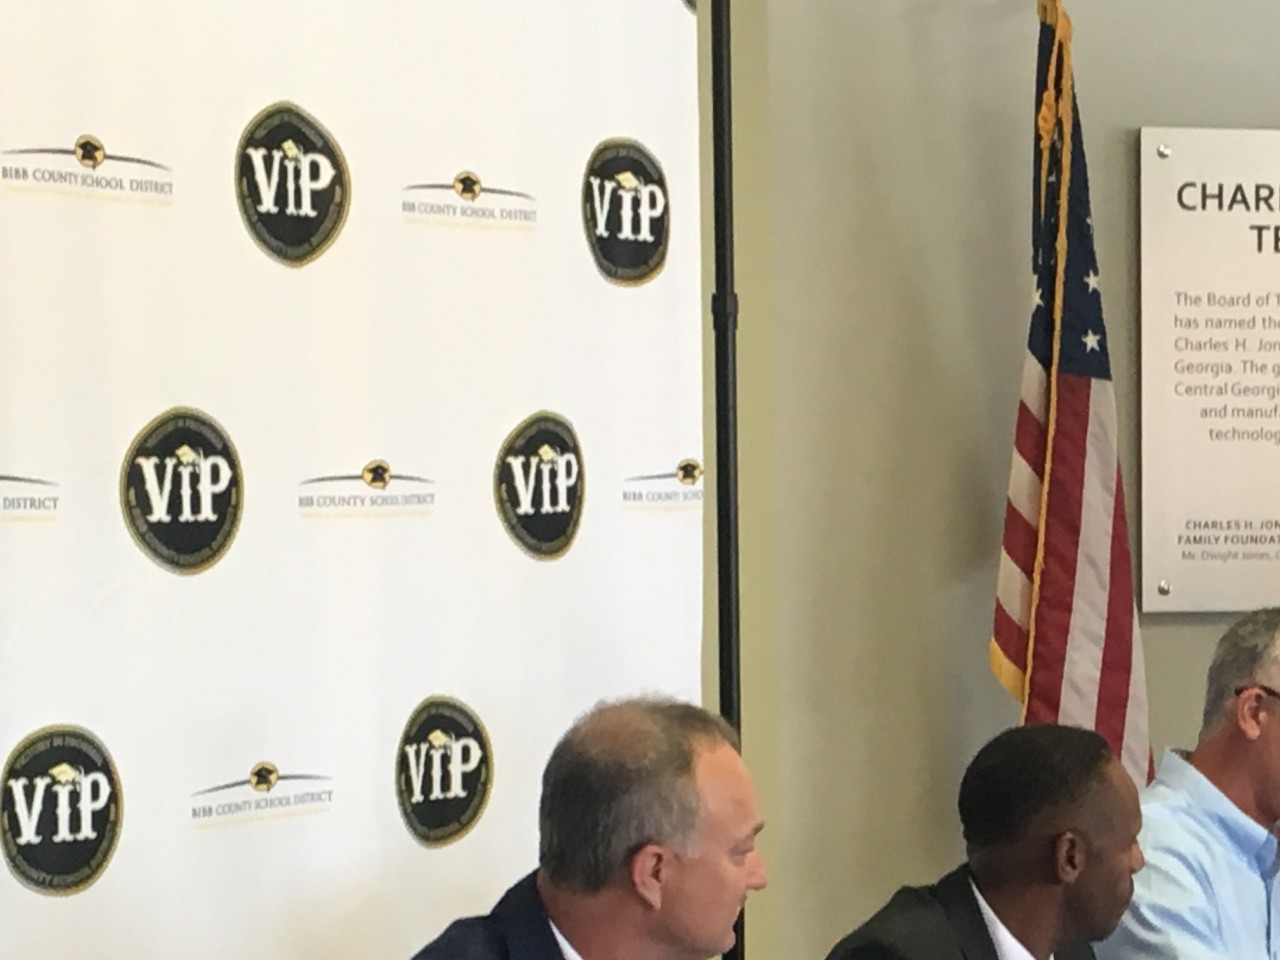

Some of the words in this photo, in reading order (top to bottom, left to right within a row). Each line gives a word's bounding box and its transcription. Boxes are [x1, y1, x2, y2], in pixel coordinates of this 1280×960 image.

[1, 166, 29, 181] BIBB
[32, 169, 79, 187] COUNTY
[80, 174, 124, 190] SCHOOL
[129, 179, 173, 195] DISTRICT
[245, 147, 335, 218] VIP
[417, 202, 458, 216] COUNTY
[460, 206, 497, 219] SCHOOL
[500, 209, 537, 222] DISTRICT
[588, 175, 666, 243] VIP
[1174, 292, 1201, 307] The
[1207, 292, 1250, 308] Board
[1256, 293, 1270, 308] of
[1174, 314, 1199, 330] has
[1205, 315, 1255, 330] named
[1174, 337, 1229, 352] Charles
[1241, 360, 1268, 374] The
[1174, 382, 1228, 397] Central
[1200, 404, 1227, 419] and
[135, 455, 233, 523] VIP
[505, 453, 579, 515] VIP
[2, 497, 59, 511] DISTRICT
[316, 495, 366, 507] COUNTY
[1185, 520, 1241, 530] CHARLES
[1177, 535, 1220, 545] FAMILY
[404, 737, 483, 804] VIP
[7, 771, 111, 846] VIP
[191, 806, 213, 819] BIBB
[215, 801, 251, 817] COUNTY
[254, 797, 291, 813] SCHOOL
[293, 790, 334, 807] DISTRICT
